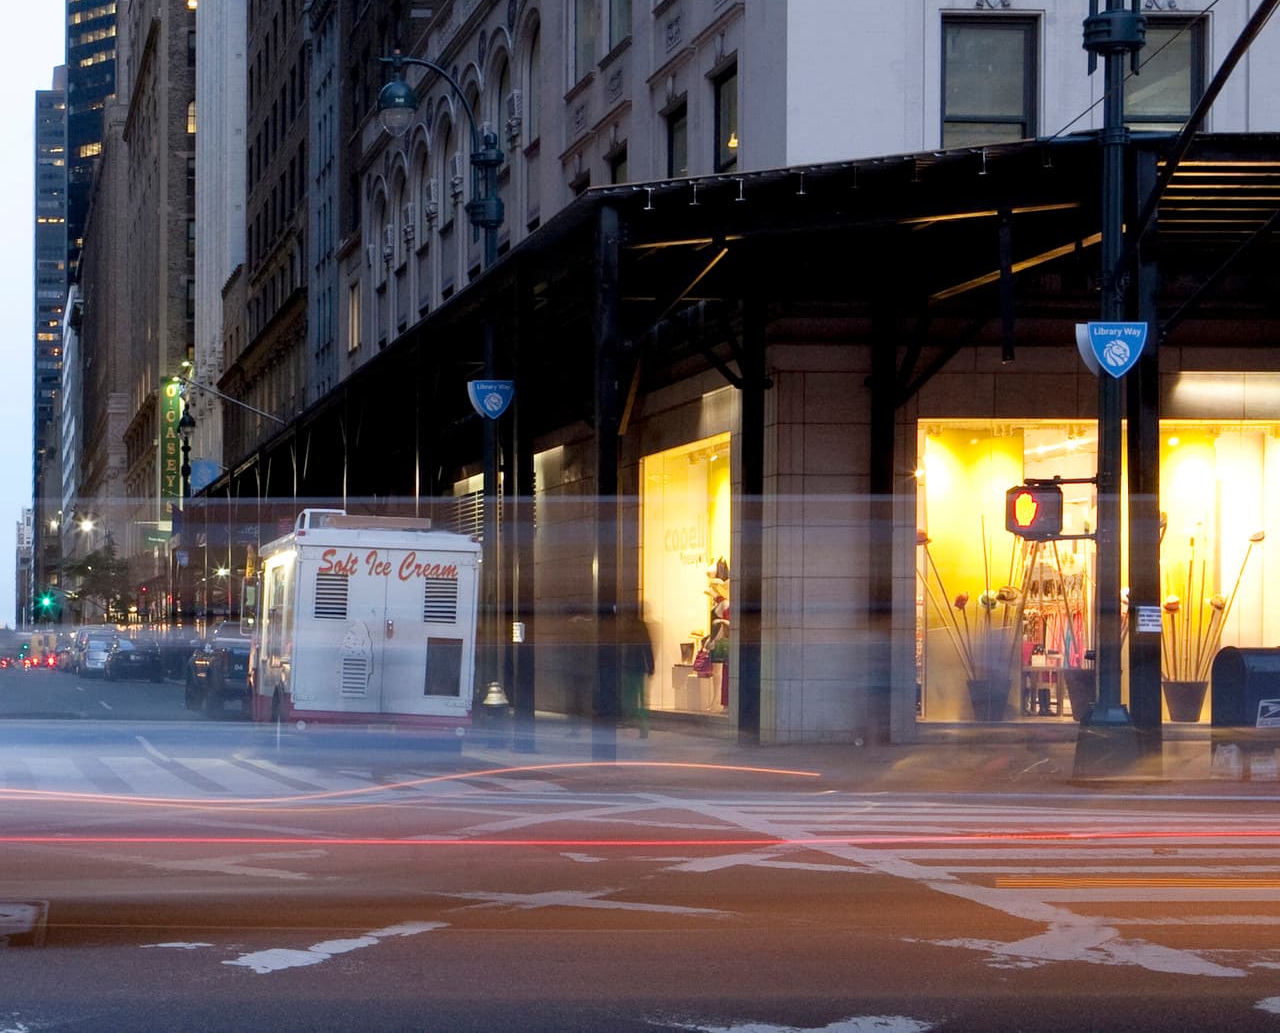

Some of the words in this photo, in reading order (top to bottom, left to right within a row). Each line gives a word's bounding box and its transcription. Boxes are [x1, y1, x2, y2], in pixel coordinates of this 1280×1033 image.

[1094, 327, 1122, 337] Library
[1124, 327, 1141, 337] Way
[318, 548, 359, 576] Soft
[365, 550, 392, 576] Ice
[398, 551, 458, 581] Cream
